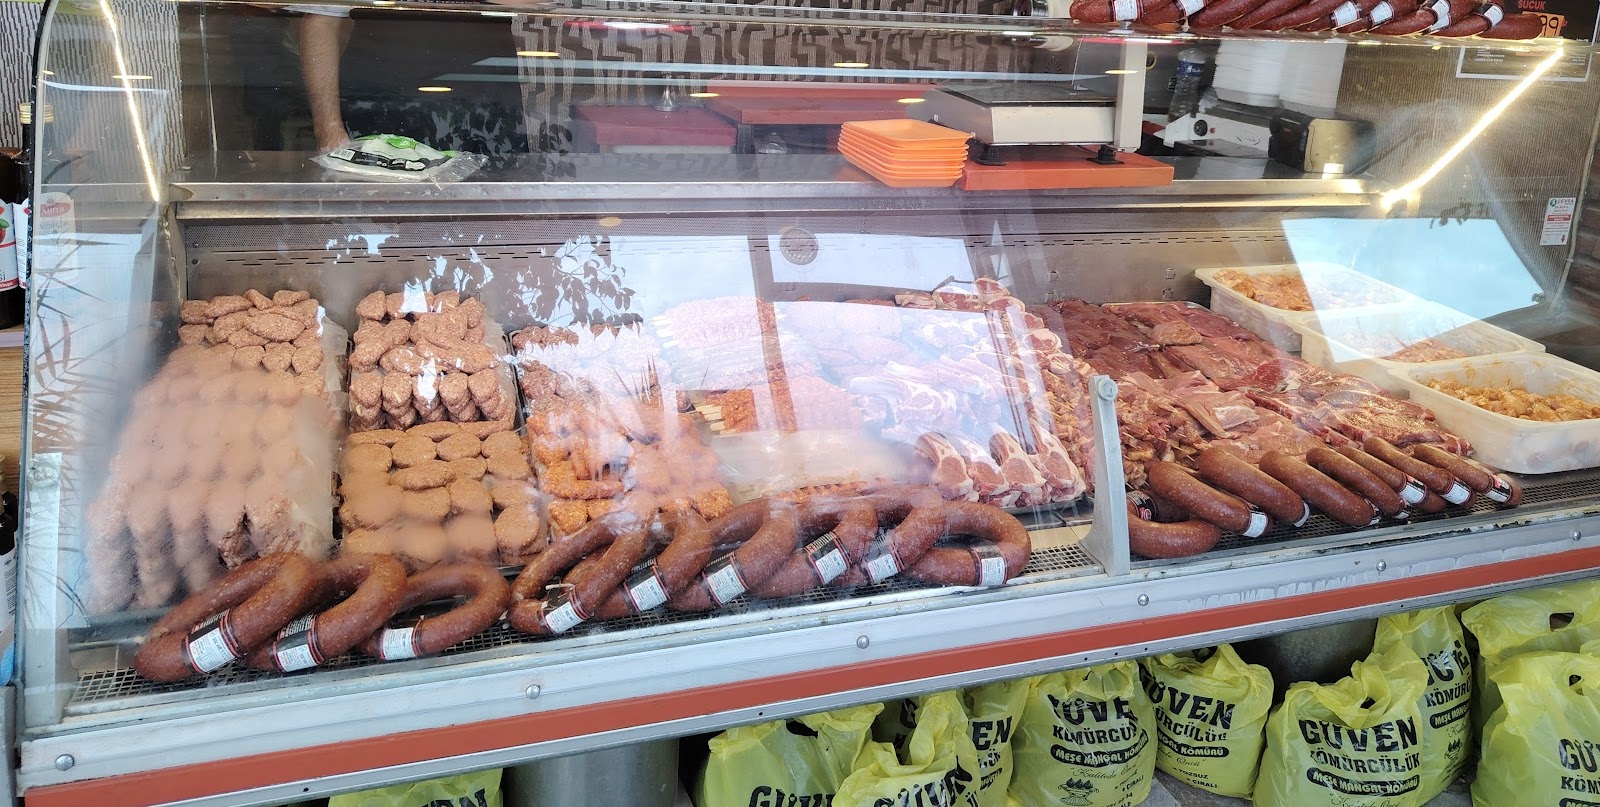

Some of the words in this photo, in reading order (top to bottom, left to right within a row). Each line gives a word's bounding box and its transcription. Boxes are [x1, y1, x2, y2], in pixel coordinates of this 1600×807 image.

[1518, 0, 1546, 10] SUCUK
[1299, 716, 1418, 752] GÜVEN
[1180, 745, 1224, 756] KÖMÜRÜ
[1055, 749, 1082, 763] MEŞE
[1083, 752, 1122, 765] MANGAL
[1179, 768, 1209, 780] TOZSUZ
